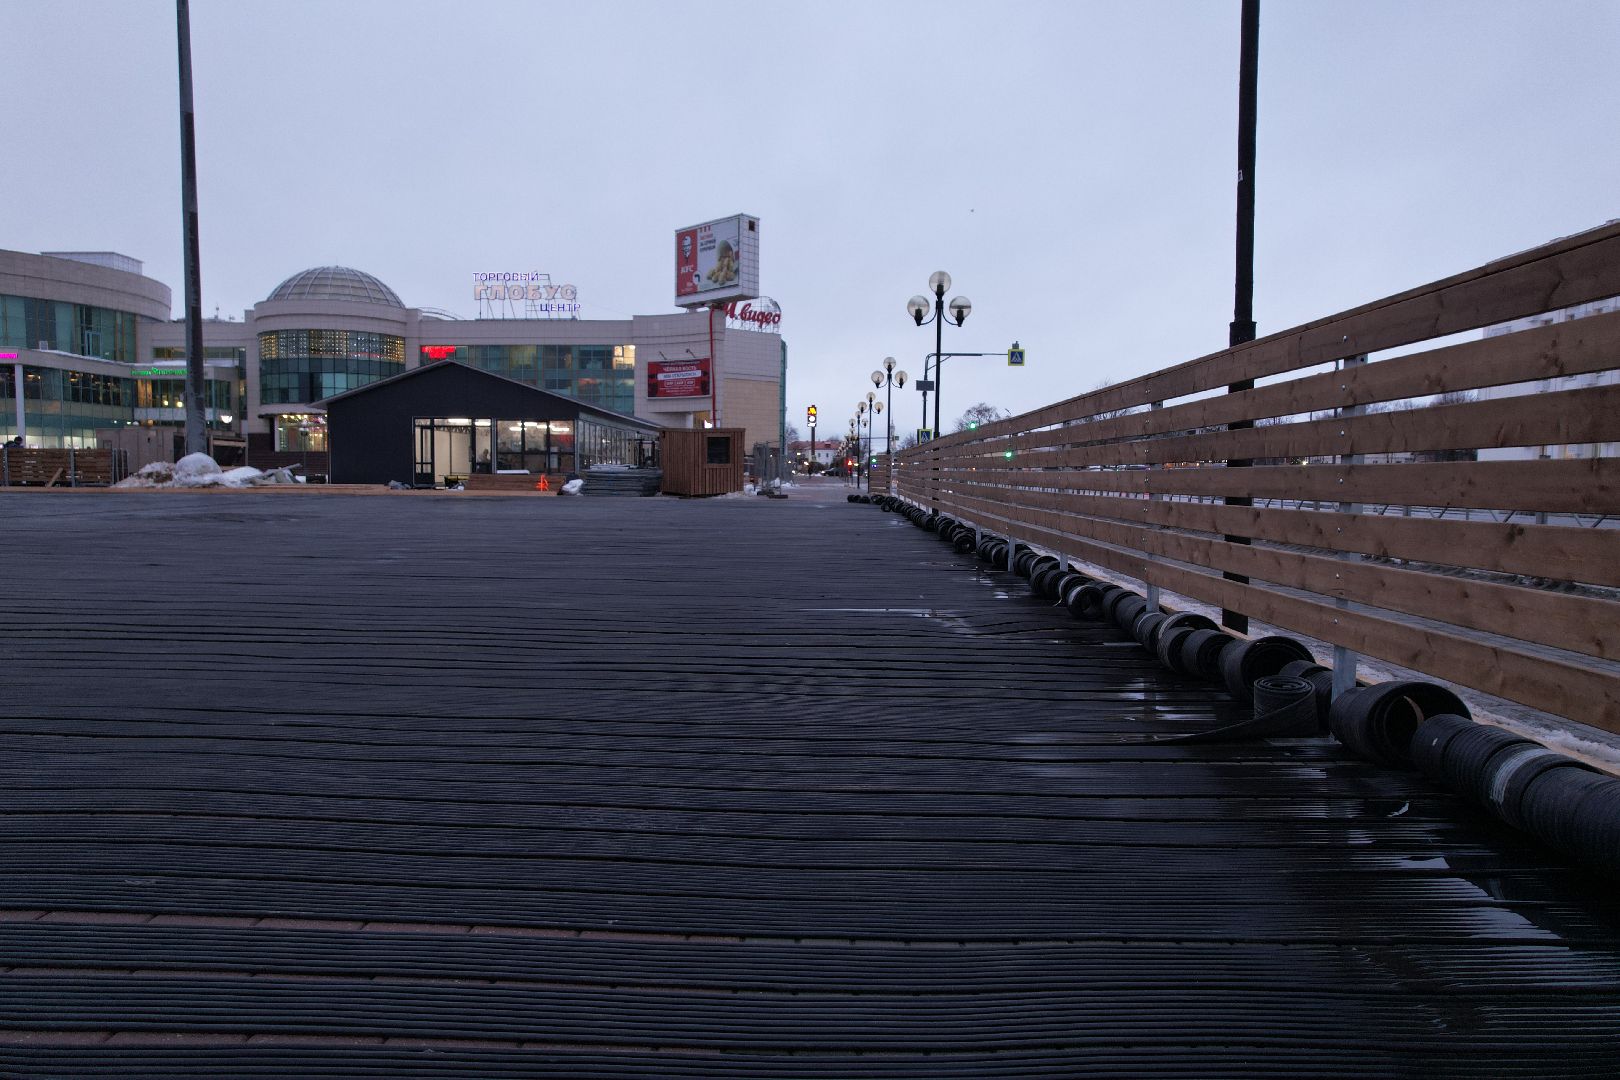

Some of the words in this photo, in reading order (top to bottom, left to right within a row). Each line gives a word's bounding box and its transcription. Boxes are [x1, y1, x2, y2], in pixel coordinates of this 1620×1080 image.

[473, 271, 539, 281] ТОРГОВЫЙ
[474, 284, 577, 300] ГЛОБУС
[540, 304, 581, 312] ЦЕНТР
